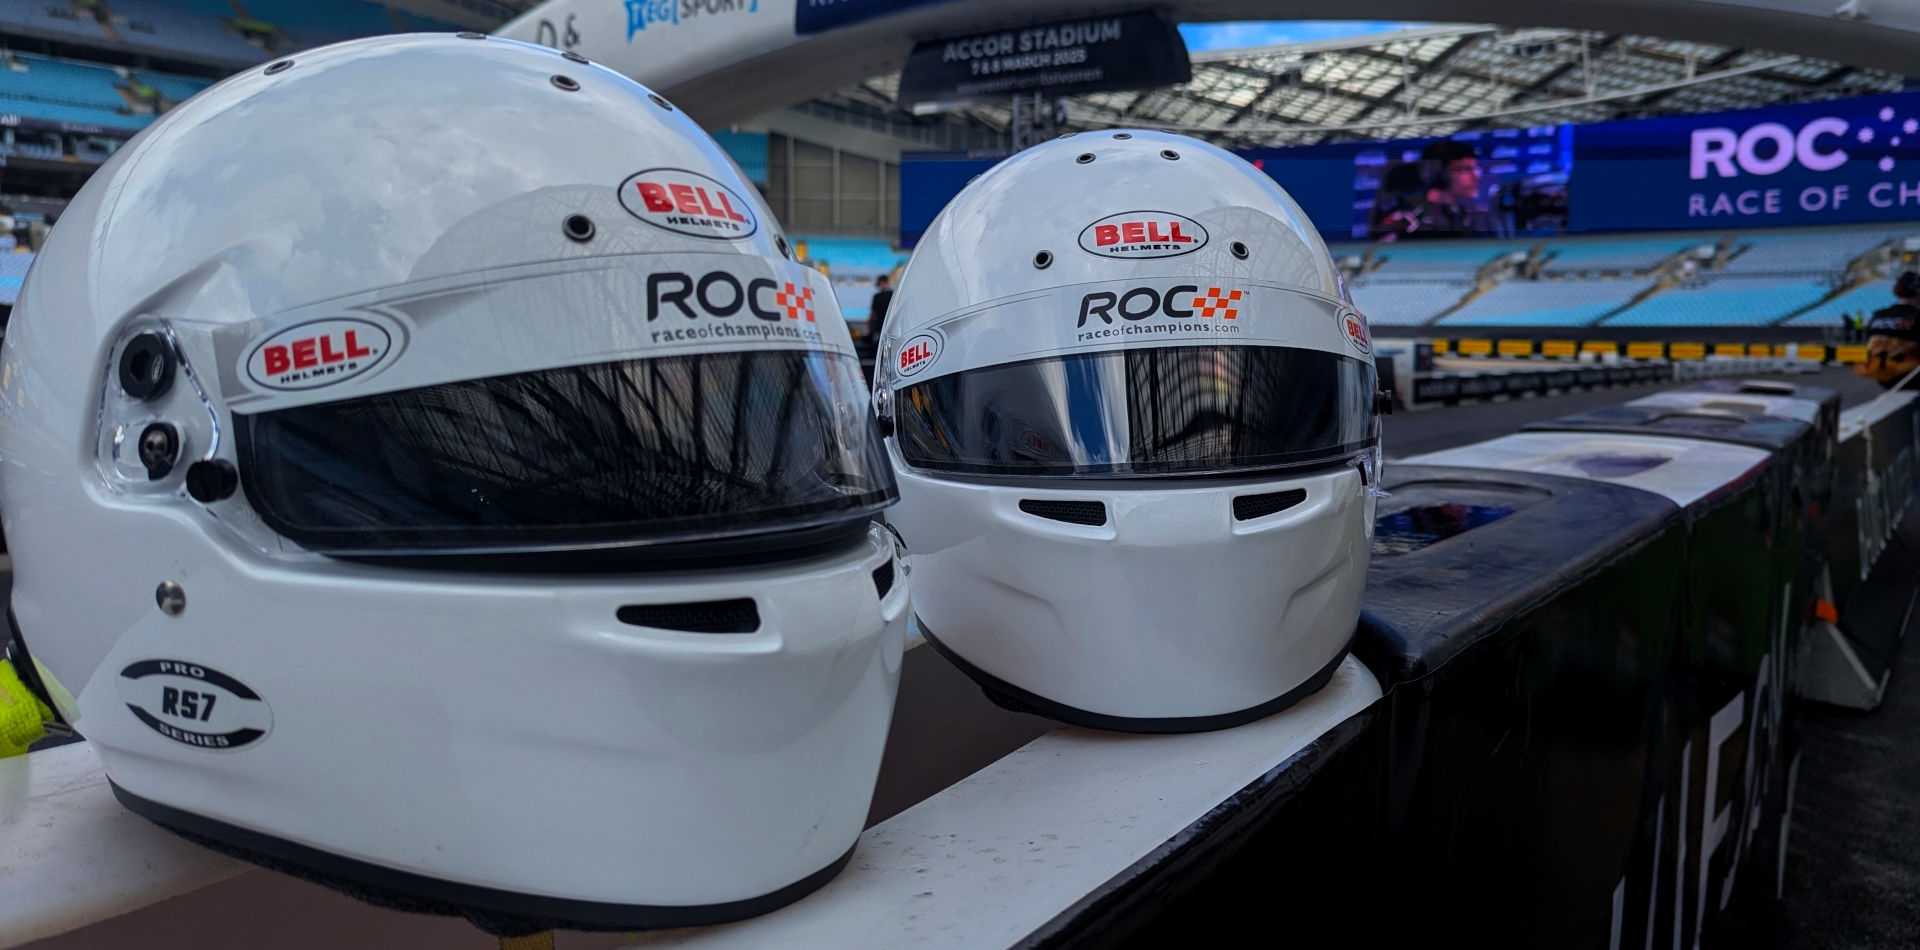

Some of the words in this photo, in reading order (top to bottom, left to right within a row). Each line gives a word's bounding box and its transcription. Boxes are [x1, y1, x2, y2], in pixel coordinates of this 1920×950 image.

[942, 32, 1015, 63] ACCOR
[1018, 19, 1121, 52] STADIUM
[1001, 53, 1051, 71] MARCH
[1689, 116, 1849, 180] ROC
[1688, 189, 1782, 218] RACE
[1800, 185, 1849, 212] OF
[666, 216, 740, 231] HELMETS
[1109, 244, 1182, 253] HELMETS
[646, 271, 782, 322] ROC
[1077, 285, 1198, 328] ROC
[1078, 322, 1239, 342] raceofchampions.com
[280, 362, 358, 384] HELMETS
[159, 661, 206, 679] PRO
[162, 686, 217, 722] RS7
[159, 723, 229, 747] SERIES
